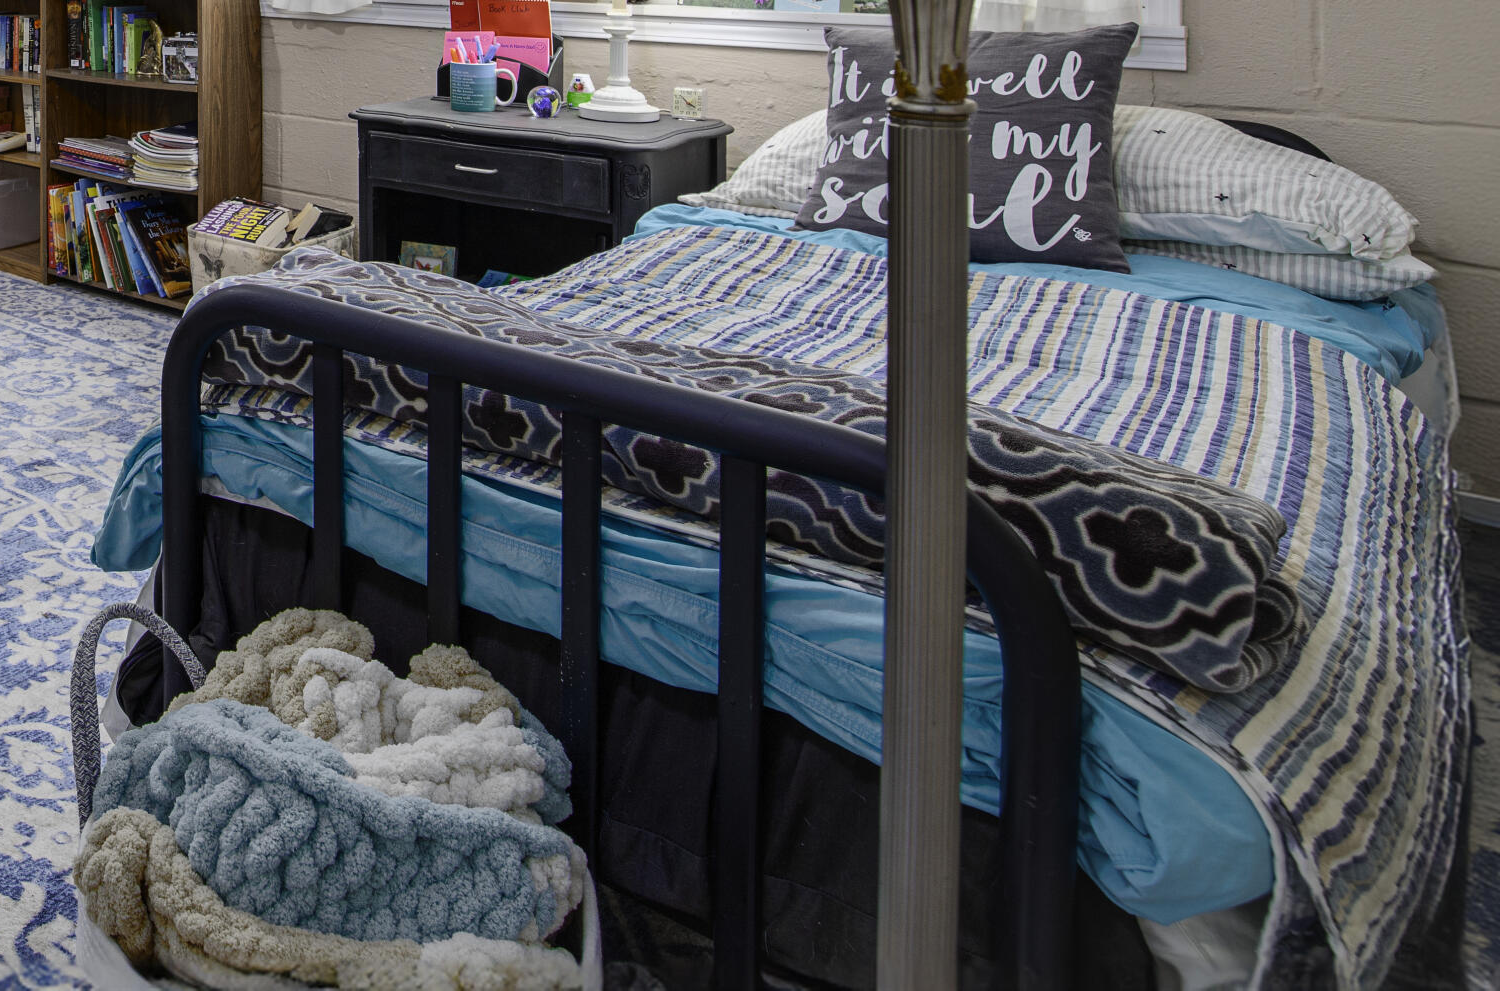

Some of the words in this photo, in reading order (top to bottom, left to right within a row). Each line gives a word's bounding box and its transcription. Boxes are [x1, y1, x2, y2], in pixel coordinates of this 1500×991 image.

[489, 5, 507, 13] Book
[511, 5, 530, 13] Club
[830, 46, 871, 108] It
[991, 120, 1102, 202] my
[194, 200, 234, 231] WILLIAM
[207, 201, 244, 233] LASHNER
[219, 222, 236, 235] THE
[230, 208, 270, 239] NIGHT
[246, 224, 267, 240] RUN
